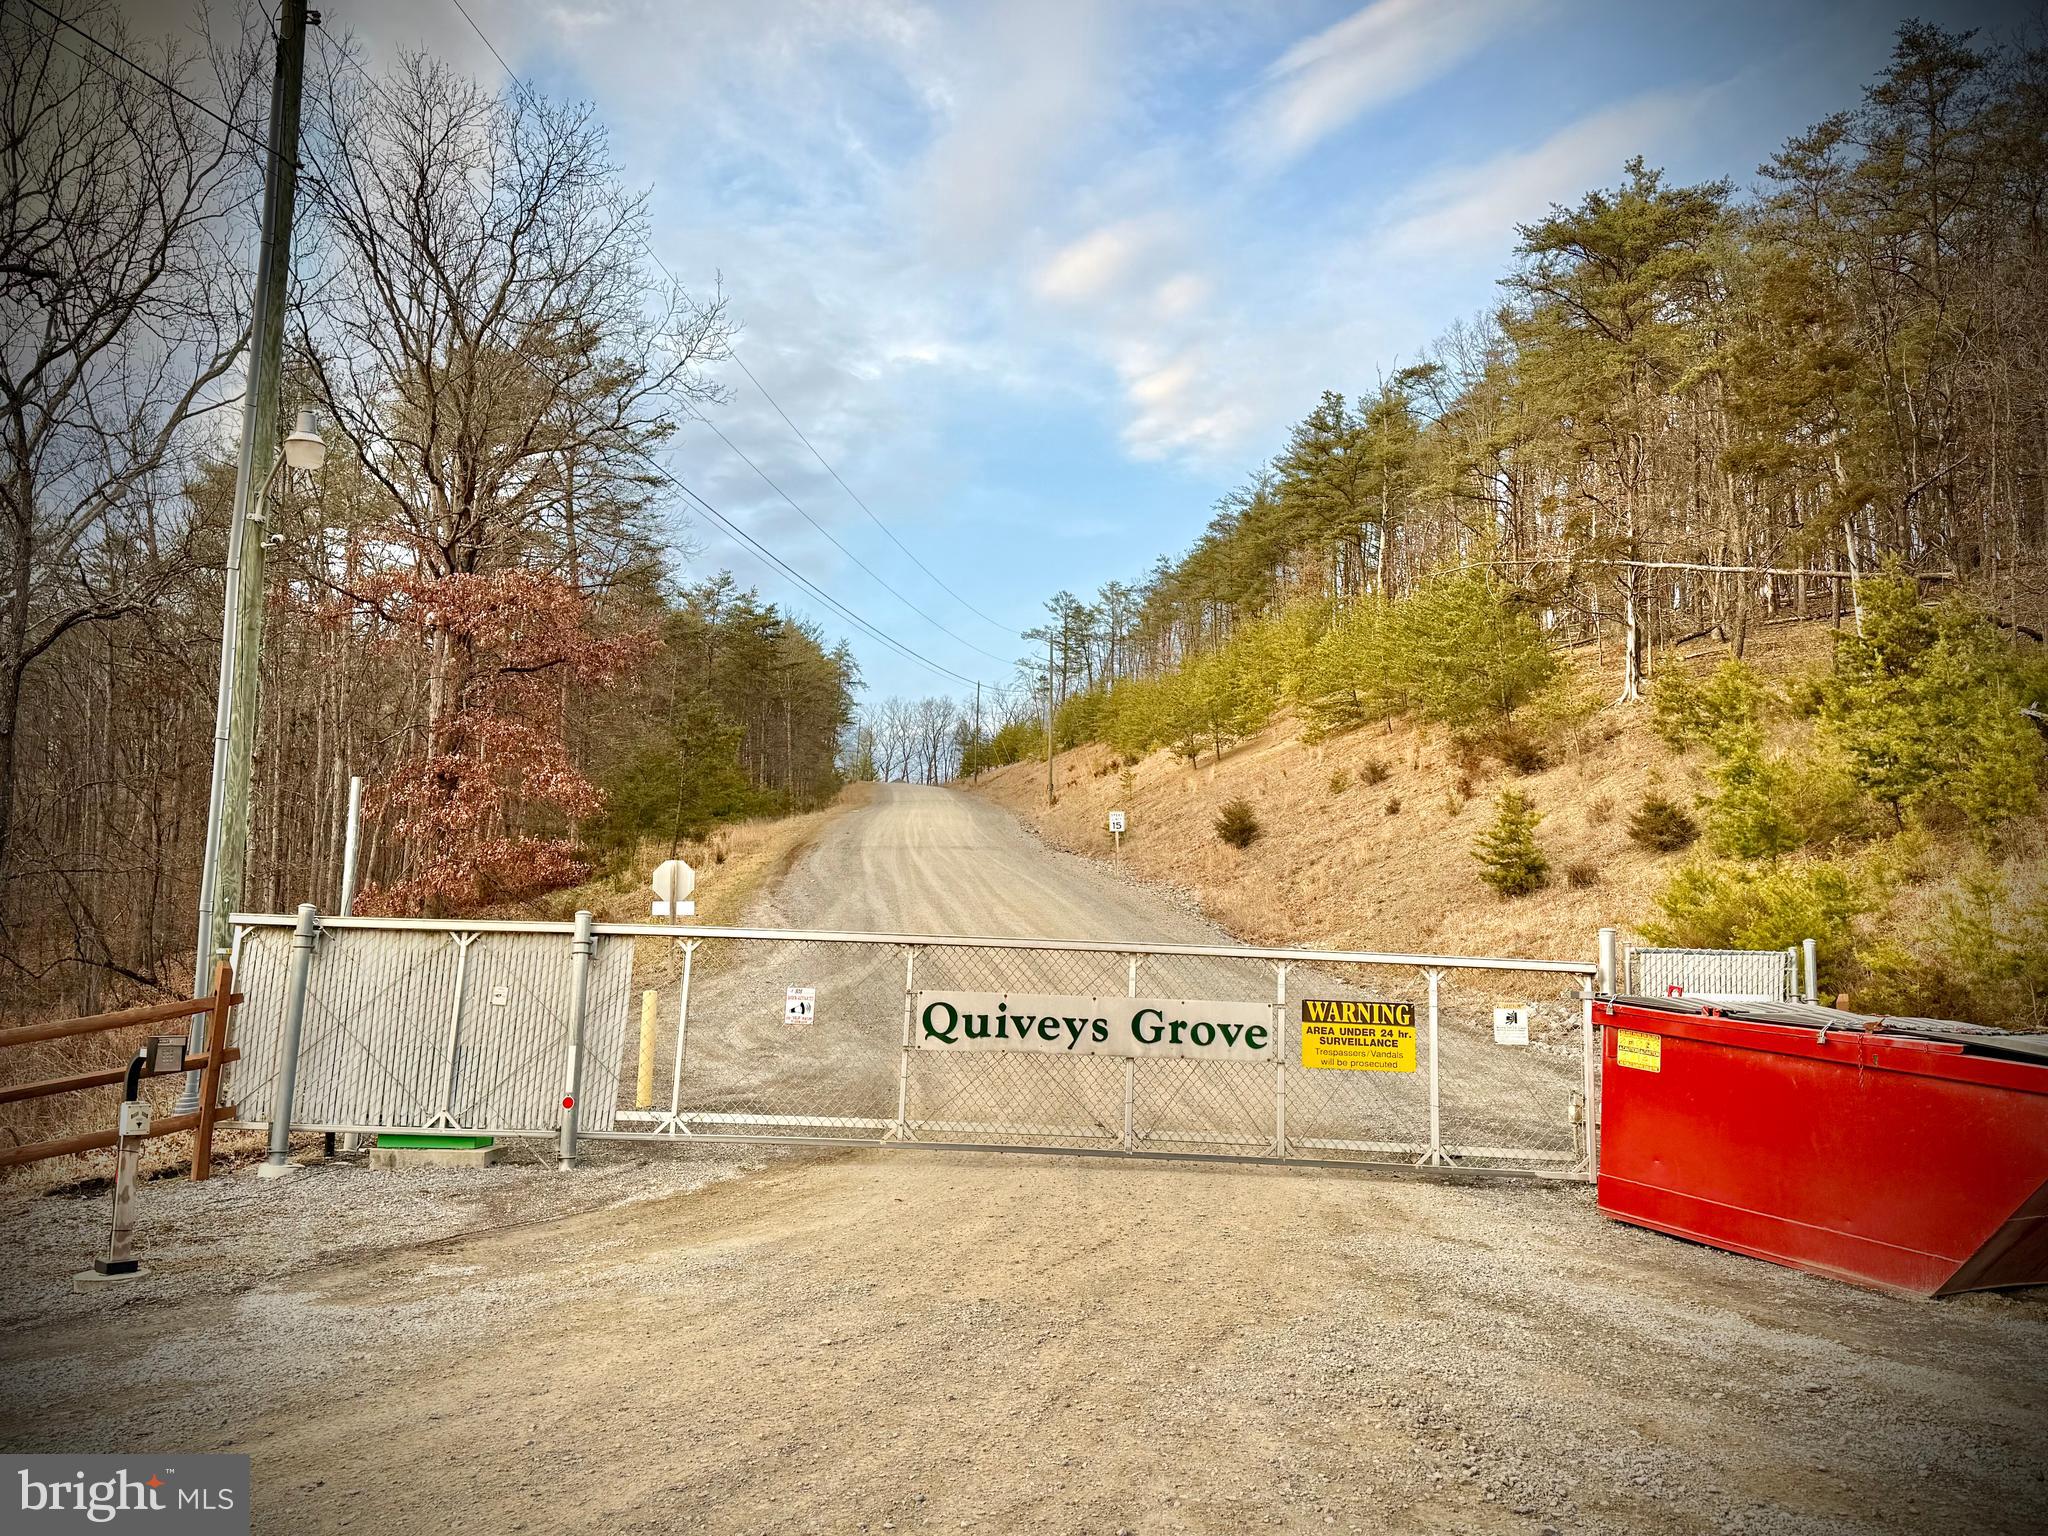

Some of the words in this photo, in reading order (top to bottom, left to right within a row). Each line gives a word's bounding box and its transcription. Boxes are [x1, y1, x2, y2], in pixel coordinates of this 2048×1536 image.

[1112, 821, 1122, 830] 15
[1306, 1001, 1411, 1026] WARNING
[922, 1001, 1109, 1050] Quiveys
[1131, 1008, 1268, 1050] Grove
[1306, 1026, 1335, 1035] AREA
[1340, 1028, 1376, 1037] UNDER
[1380, 1029, 1394, 1038] 24
[1398, 1030, 1412, 1039] hr.
[1319, 1036, 1399, 1048] SURVEILLANCE
[1336, 1059, 1348, 1067] be
[1350, 1060, 1398, 1069] prosecuted
